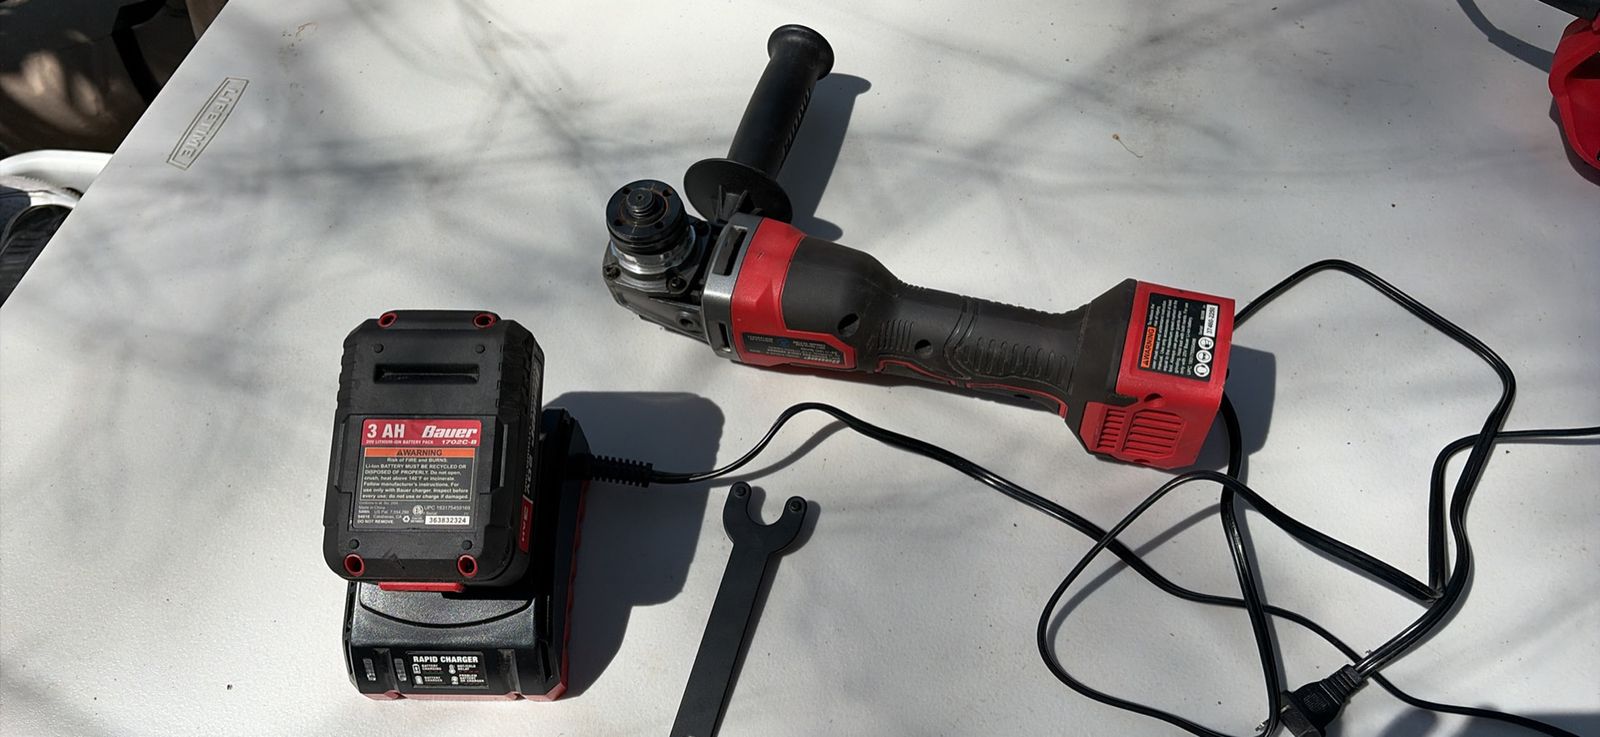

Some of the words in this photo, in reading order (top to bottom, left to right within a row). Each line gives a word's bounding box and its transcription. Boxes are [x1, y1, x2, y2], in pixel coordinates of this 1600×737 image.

[180, 85, 239, 158] LIFETIME
[1144, 328, 1154, 359] WARNING
[367, 424, 377, 438] 3
[382, 424, 405, 438] AH
[422, 425, 477, 438] Bauer
